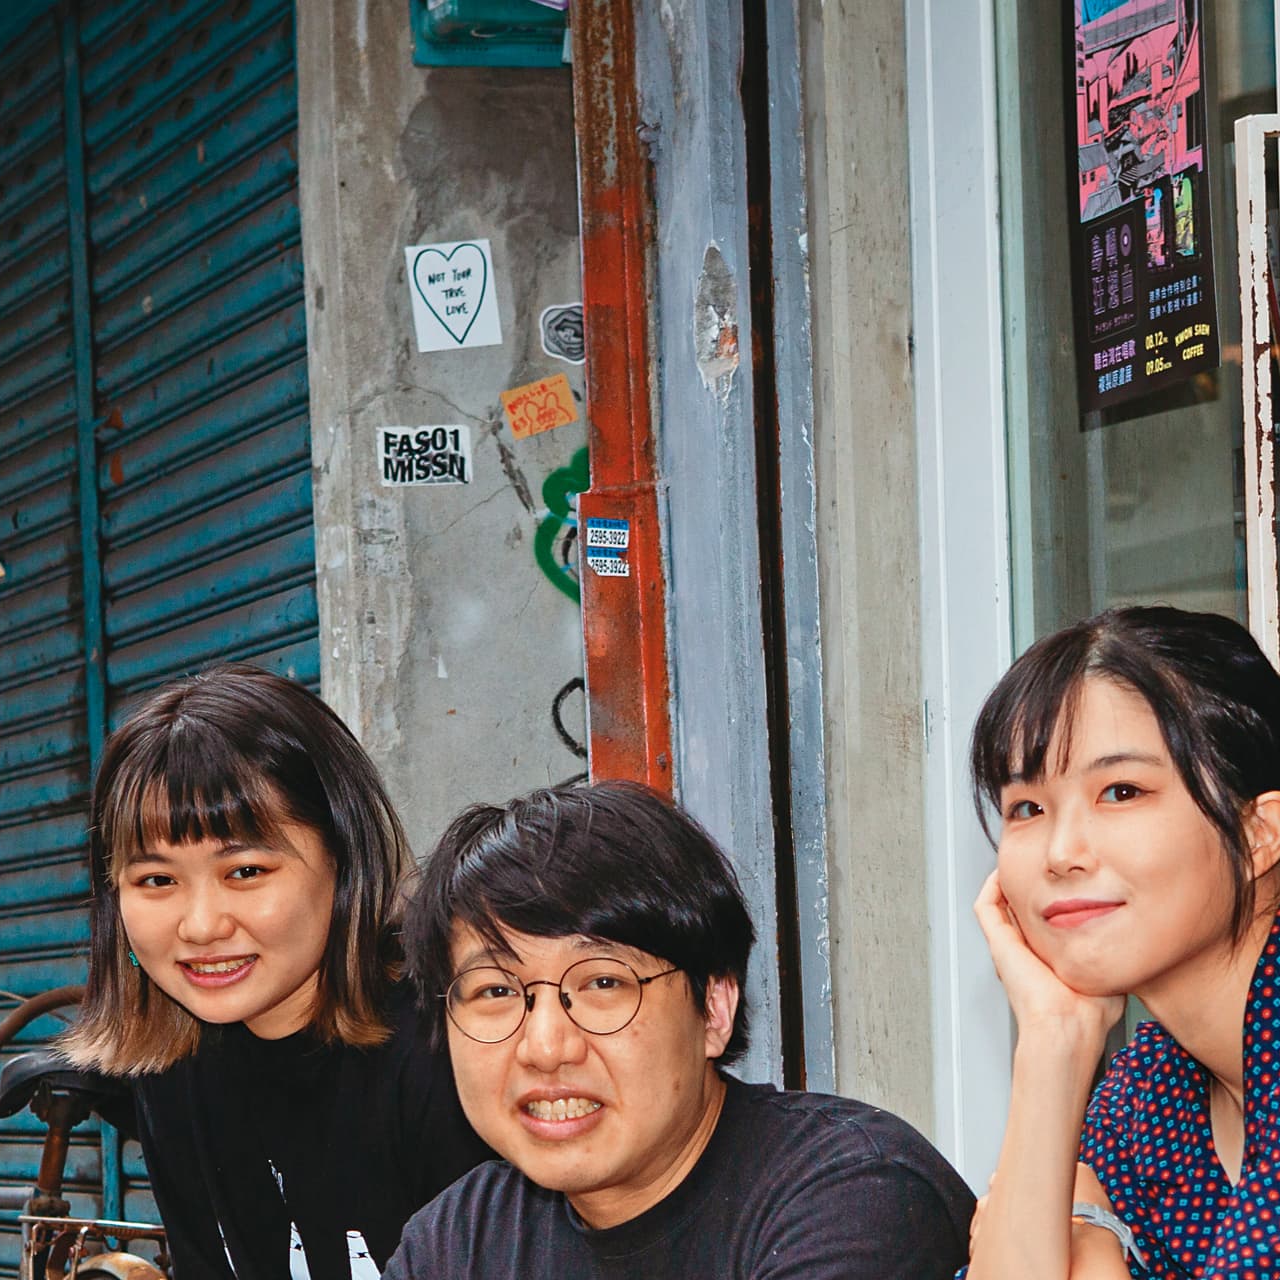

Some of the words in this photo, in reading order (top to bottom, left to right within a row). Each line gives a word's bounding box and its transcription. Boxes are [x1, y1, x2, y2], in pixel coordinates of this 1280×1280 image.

[428, 272, 445, 285] NOT
[446, 302, 468, 316] LOVE
[1183, 343, 1204, 360] COFFEE
[590, 529, 626, 545] 2595-3922
